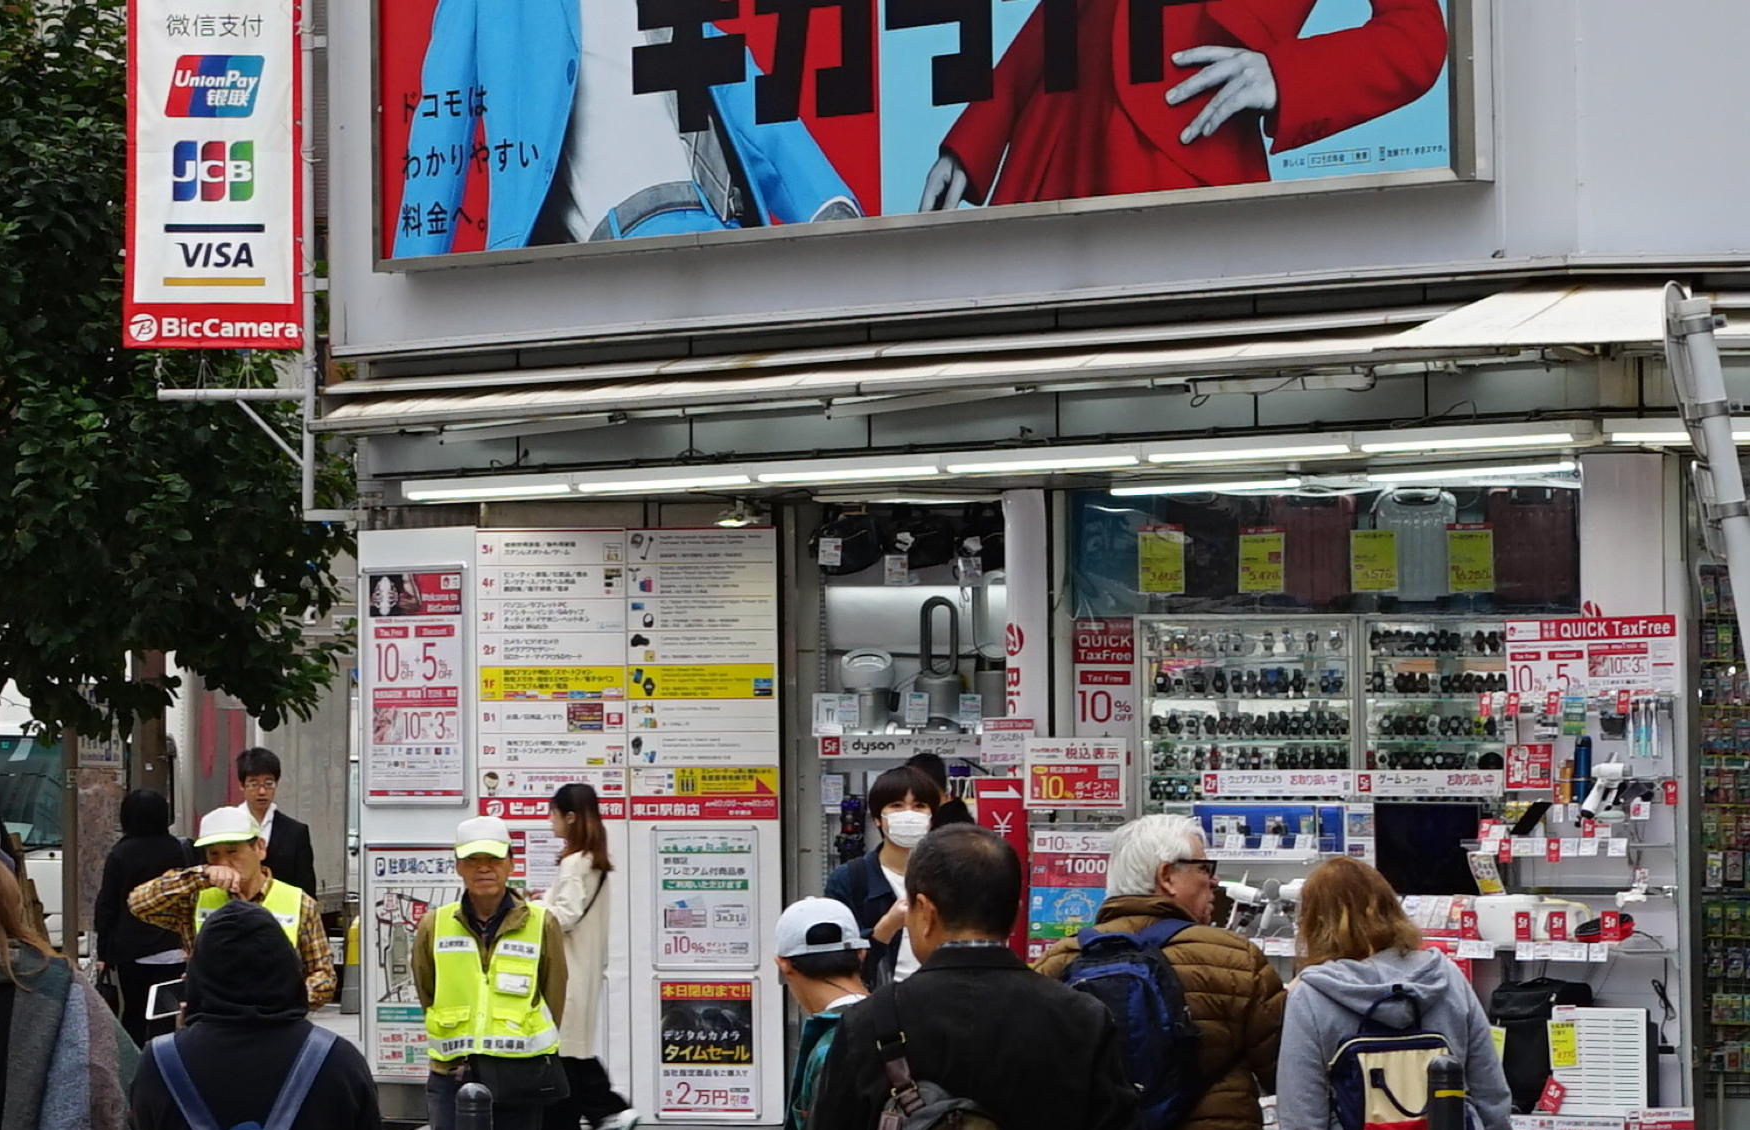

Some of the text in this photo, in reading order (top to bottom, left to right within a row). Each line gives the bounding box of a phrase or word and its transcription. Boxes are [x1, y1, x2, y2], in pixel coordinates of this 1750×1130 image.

[166, 13, 264, 38] 微信支付
[174, 69, 259, 91] UnionPay
[206, 89, 251, 107] 银联
[403, 85, 488, 124] ドコモは
[402, 138, 540, 180] わかりやすい
[172, 159, 252, 183] JCB
[402, 201, 486, 238] 料金へ。
[175, 242, 255, 268] VISA
[161, 317, 299, 339] BicCamera
[1560, 620, 1672, 638] QUICK TaxFree
[1078, 634, 1132, 648] QUICK
[1078, 649, 1131, 661] TaxFree
[1088, 674, 1123, 683] Tax Free
[823, 739, 839, 753] 5F
[852, 739, 895, 755] dyson
[1074, 781, 1112, 789] ポイント
[1378, 774, 1402, 785] ゲーム
[633, 803, 700, 816] 東口駅前店
[663, 866, 746, 876] プレミアム付商品券
[663, 1030, 741, 1041] デジタルカメラ
[664, 1043, 751, 1062] タイムセール
